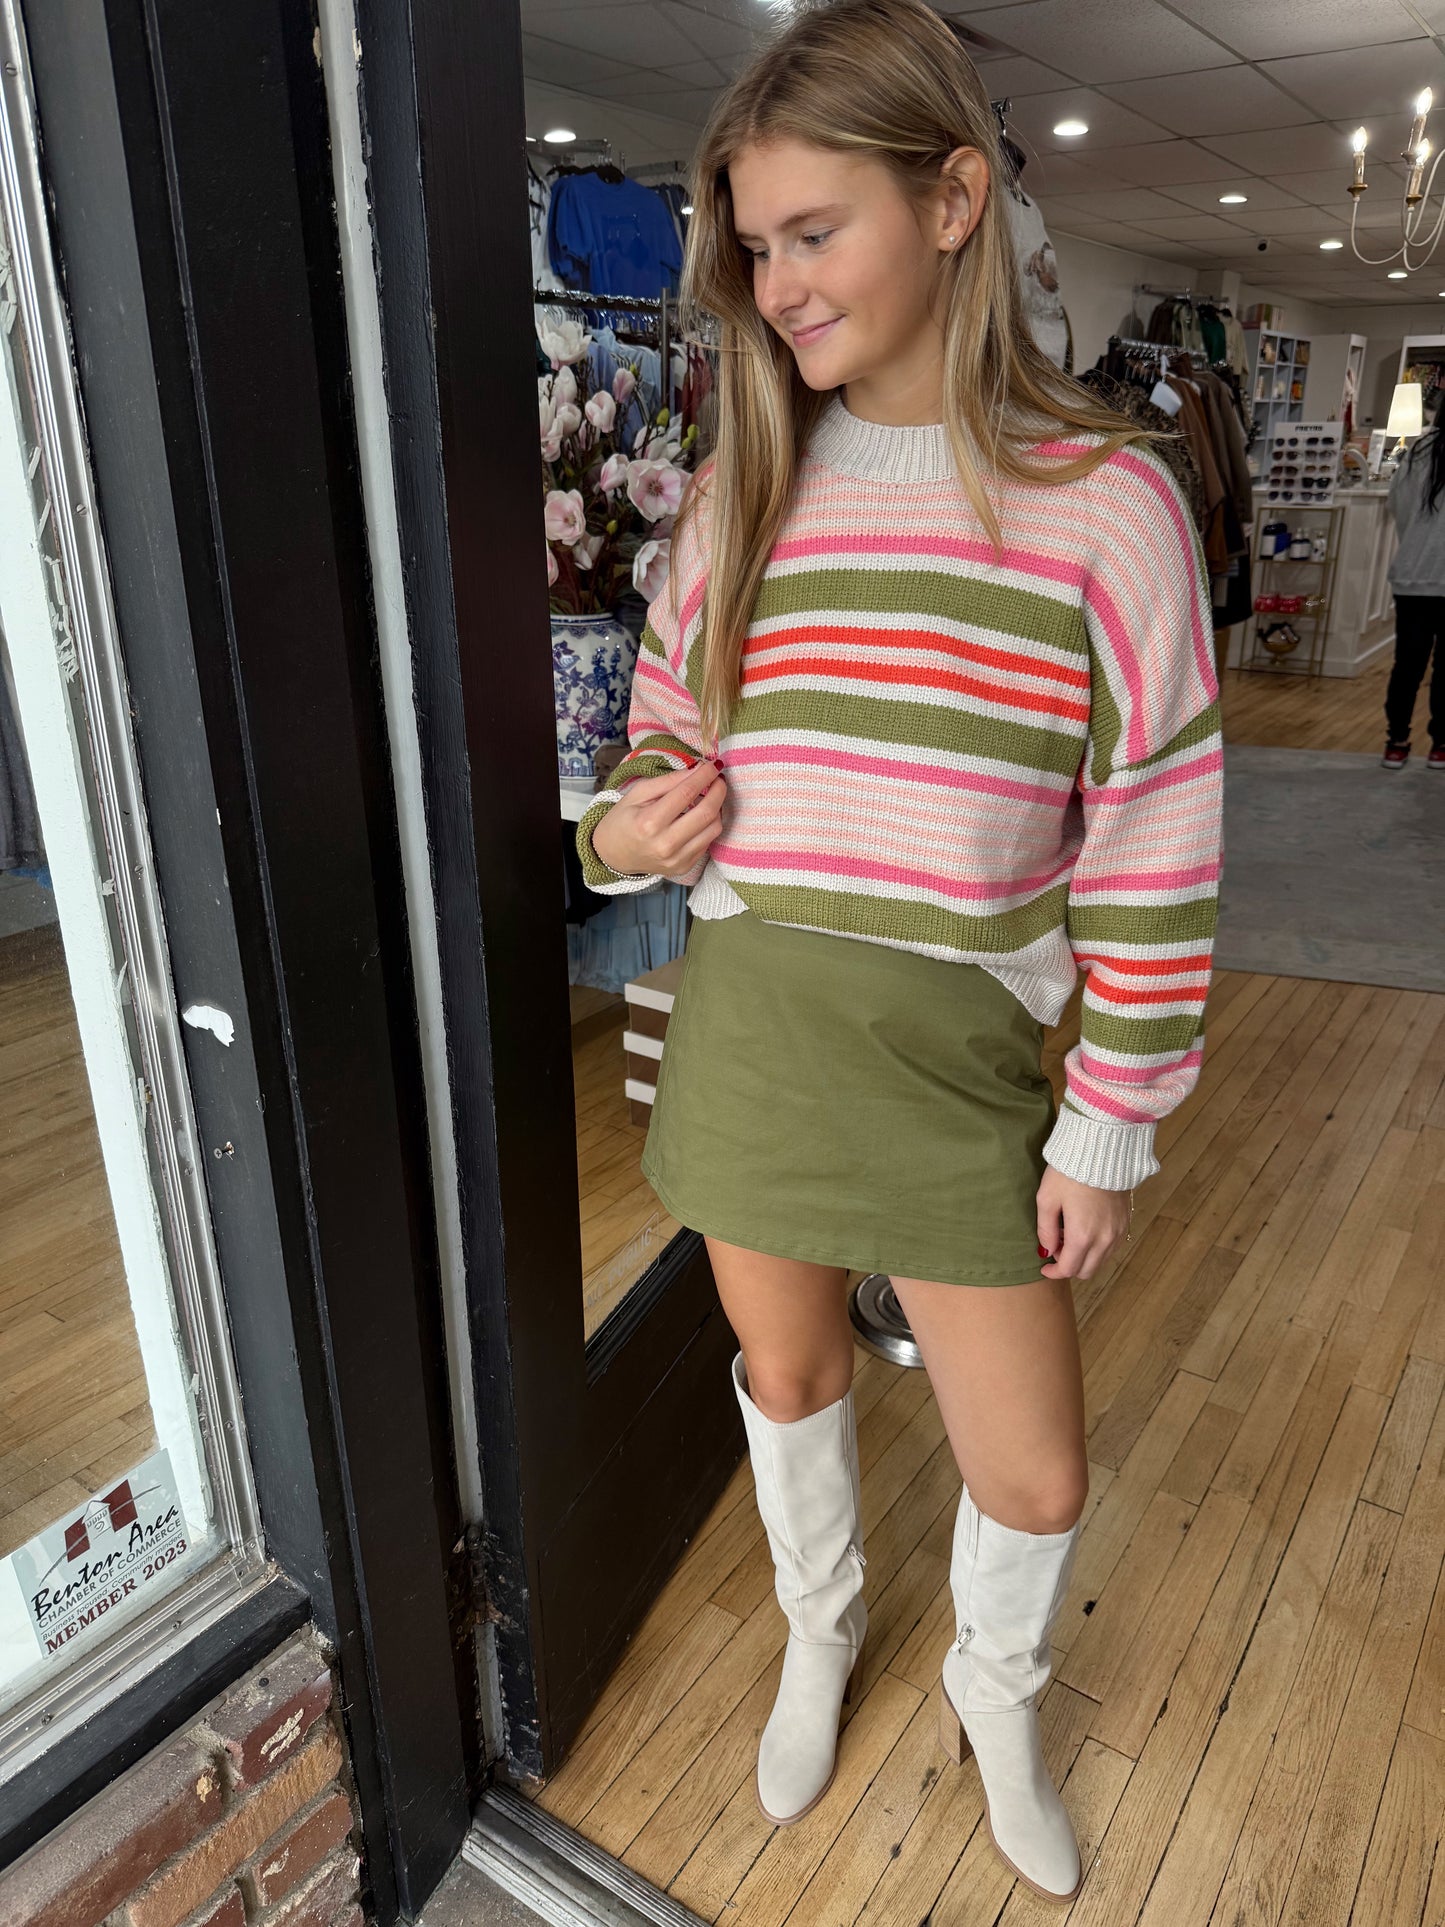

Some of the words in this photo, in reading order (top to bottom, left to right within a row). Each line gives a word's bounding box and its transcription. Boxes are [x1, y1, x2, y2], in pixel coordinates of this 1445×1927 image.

[31, 1552, 122, 1621] Benton
[128, 1505, 179, 1552] Area
[38, 1582, 97, 1628] CHAMBER
[99, 1567, 115, 1584] OF
[117, 1518, 182, 1570] COMMERCE
[45, 1577, 138, 1655] MEMBER
[142, 1538, 188, 1581] 2023
[42, 1614, 75, 1640] Business
